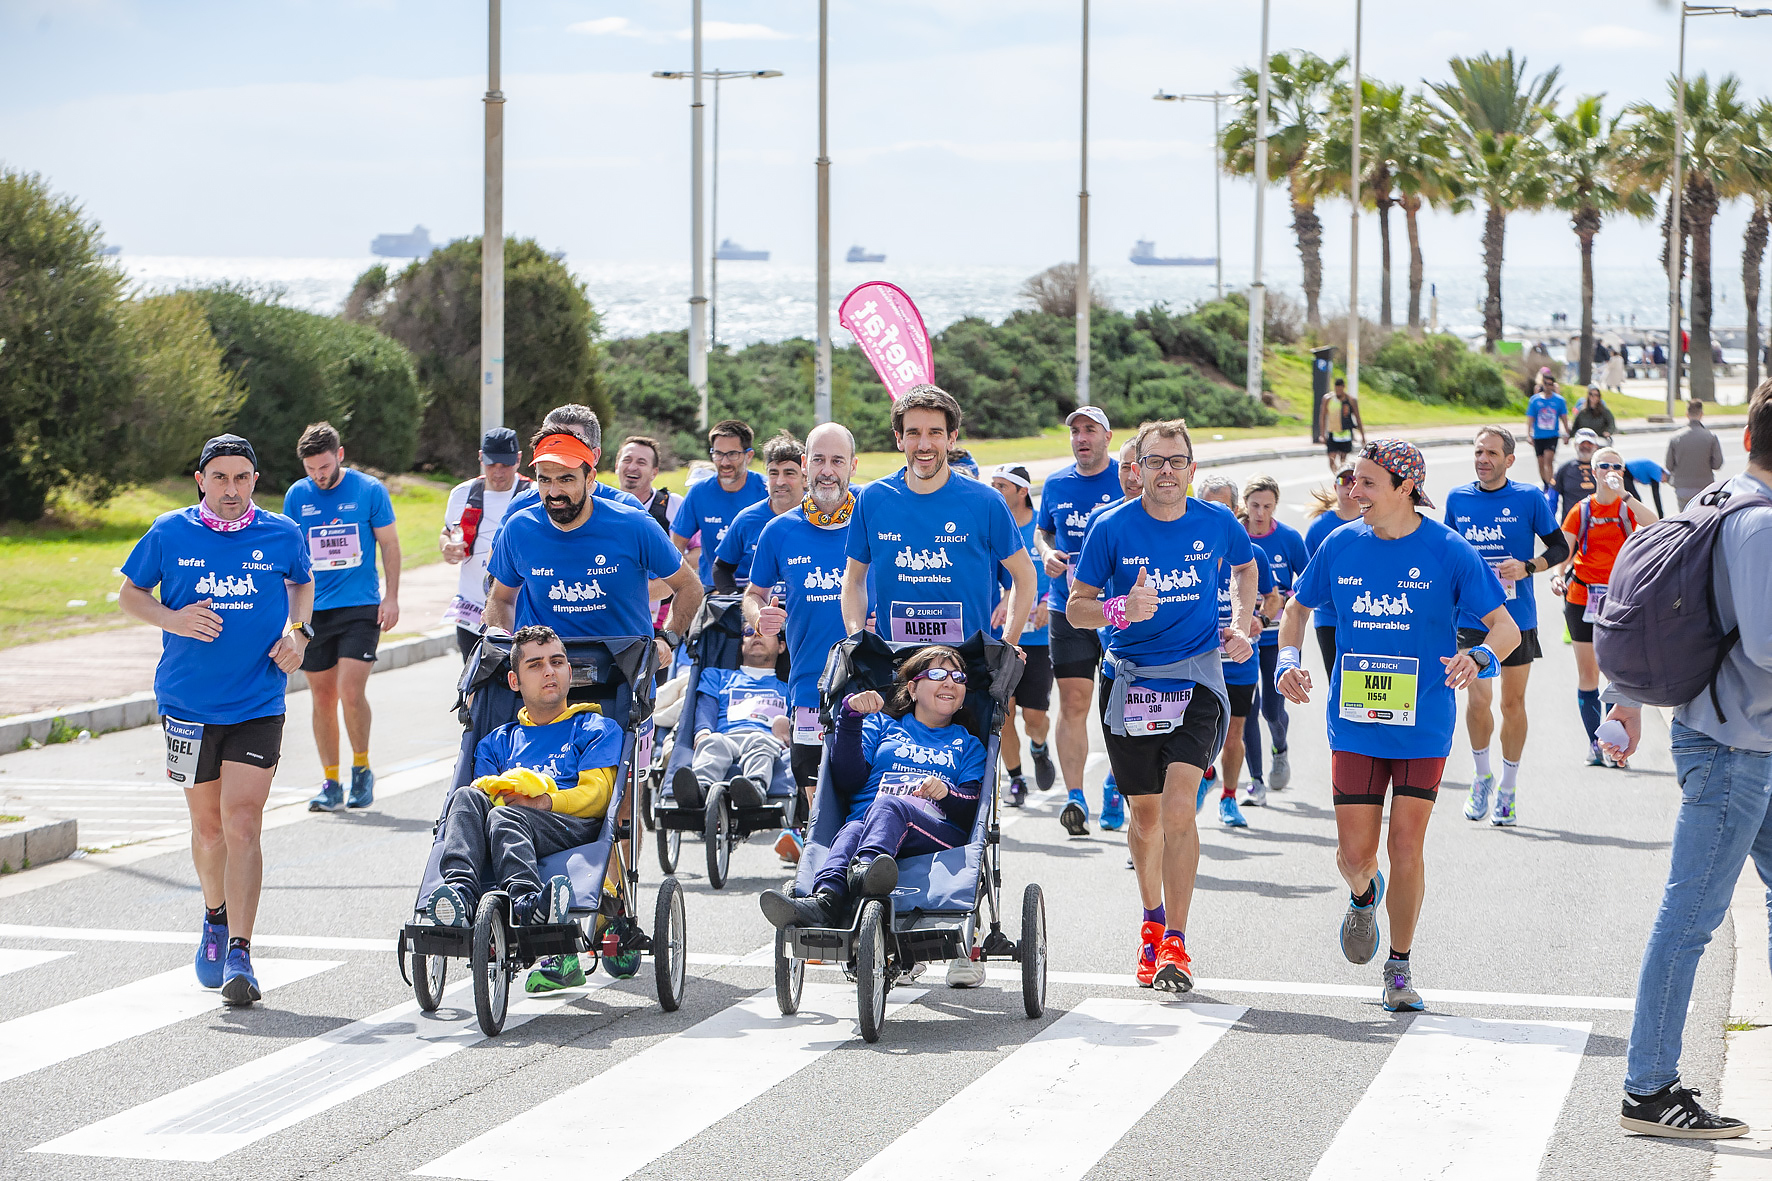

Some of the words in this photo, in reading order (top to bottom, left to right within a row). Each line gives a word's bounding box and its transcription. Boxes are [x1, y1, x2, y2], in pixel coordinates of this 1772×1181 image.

[878, 532, 902, 541] aefat
[934, 534, 969, 543] ZURICH
[320, 537, 349, 549] DANIEL
[178, 557, 206, 568] aefat
[788, 555, 812, 565] aefat
[1122, 556, 1150, 565] aefat
[241, 562, 274, 571] ZURICH
[586, 565, 618, 576] ZURICH
[531, 568, 554, 576] aefat
[897, 574, 952, 584] #Imparables
[1337, 576, 1363, 586] aefat
[1396, 581, 1431, 590] ZURICH
[552, 603, 607, 614] #Imparables
[905, 621, 948, 636] ALBERT
[1352, 620, 1411, 631] #Imparables
[1371, 662, 1398, 670] ZURICH
[1364, 674, 1392, 690] XAVI
[1160, 690, 1191, 703] JAVIER
[1367, 692, 1387, 701] 11554
[1148, 704, 1162, 713] 306
[170, 726, 196, 736] ZURICH
[167, 736, 193, 755] NGEL
